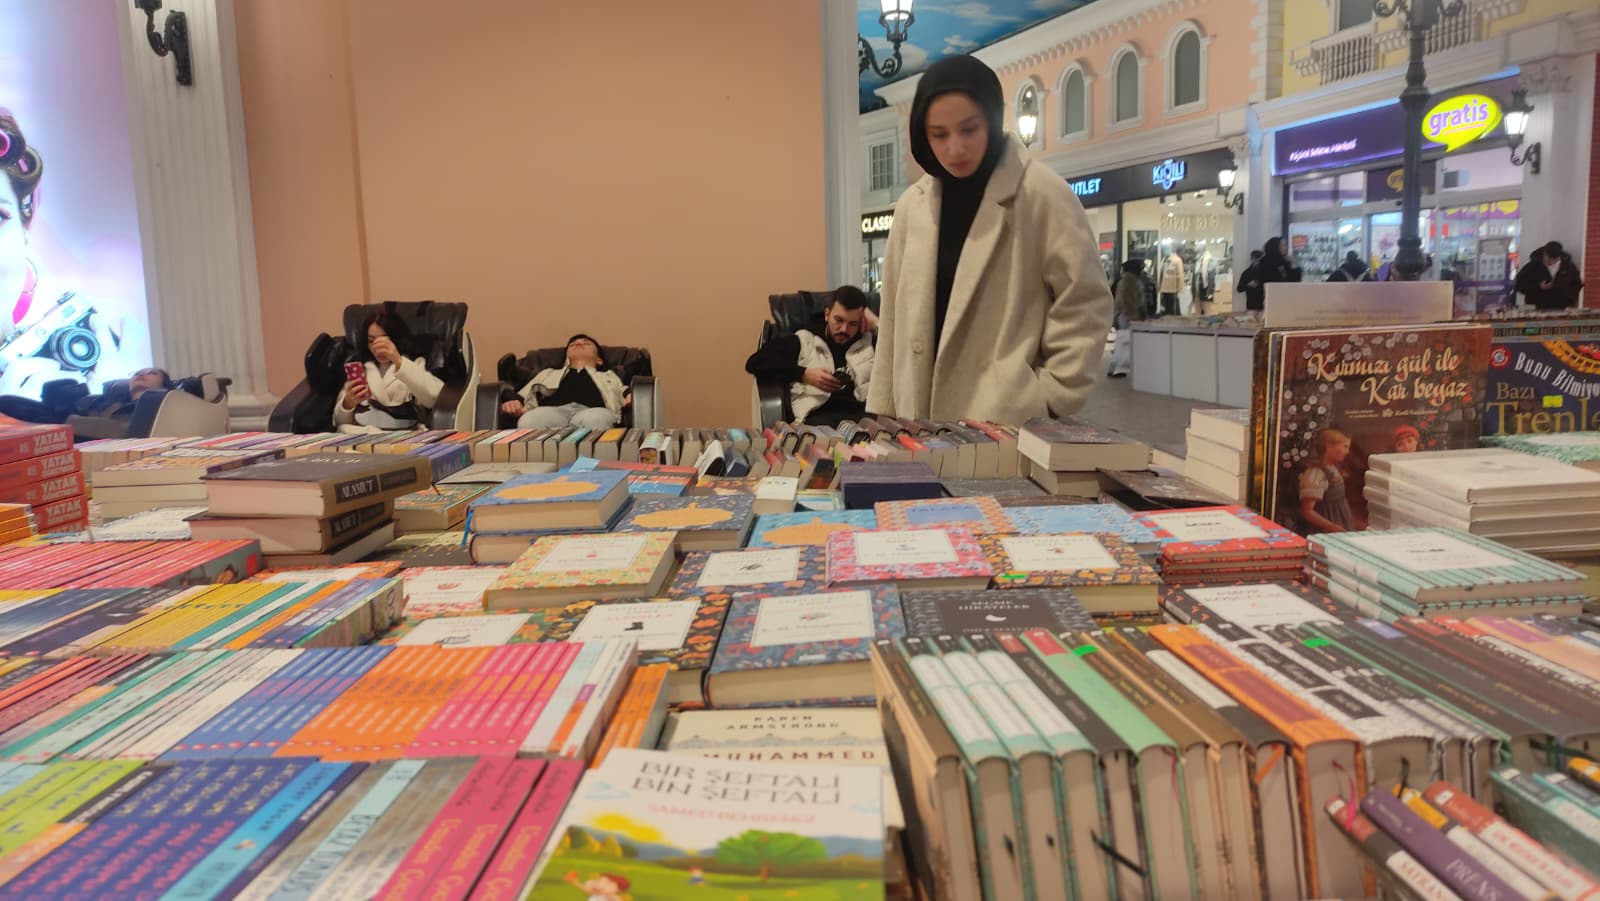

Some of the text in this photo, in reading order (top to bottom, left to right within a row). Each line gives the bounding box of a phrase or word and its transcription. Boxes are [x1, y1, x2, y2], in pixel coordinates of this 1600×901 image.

[1429, 97, 1489, 137] gratis
[1069, 178, 1102, 196] UTLET
[1307, 346, 1461, 382] Kırmızı gül ile
[1514, 351, 1553, 380] Bunu
[1360, 375, 1469, 407] Kar beyaz
[1495, 381, 1536, 400] Bazı
[33, 430, 68, 446] YATAK
[42, 475, 79, 491] YATAK
[46, 499, 82, 517] YATAK
